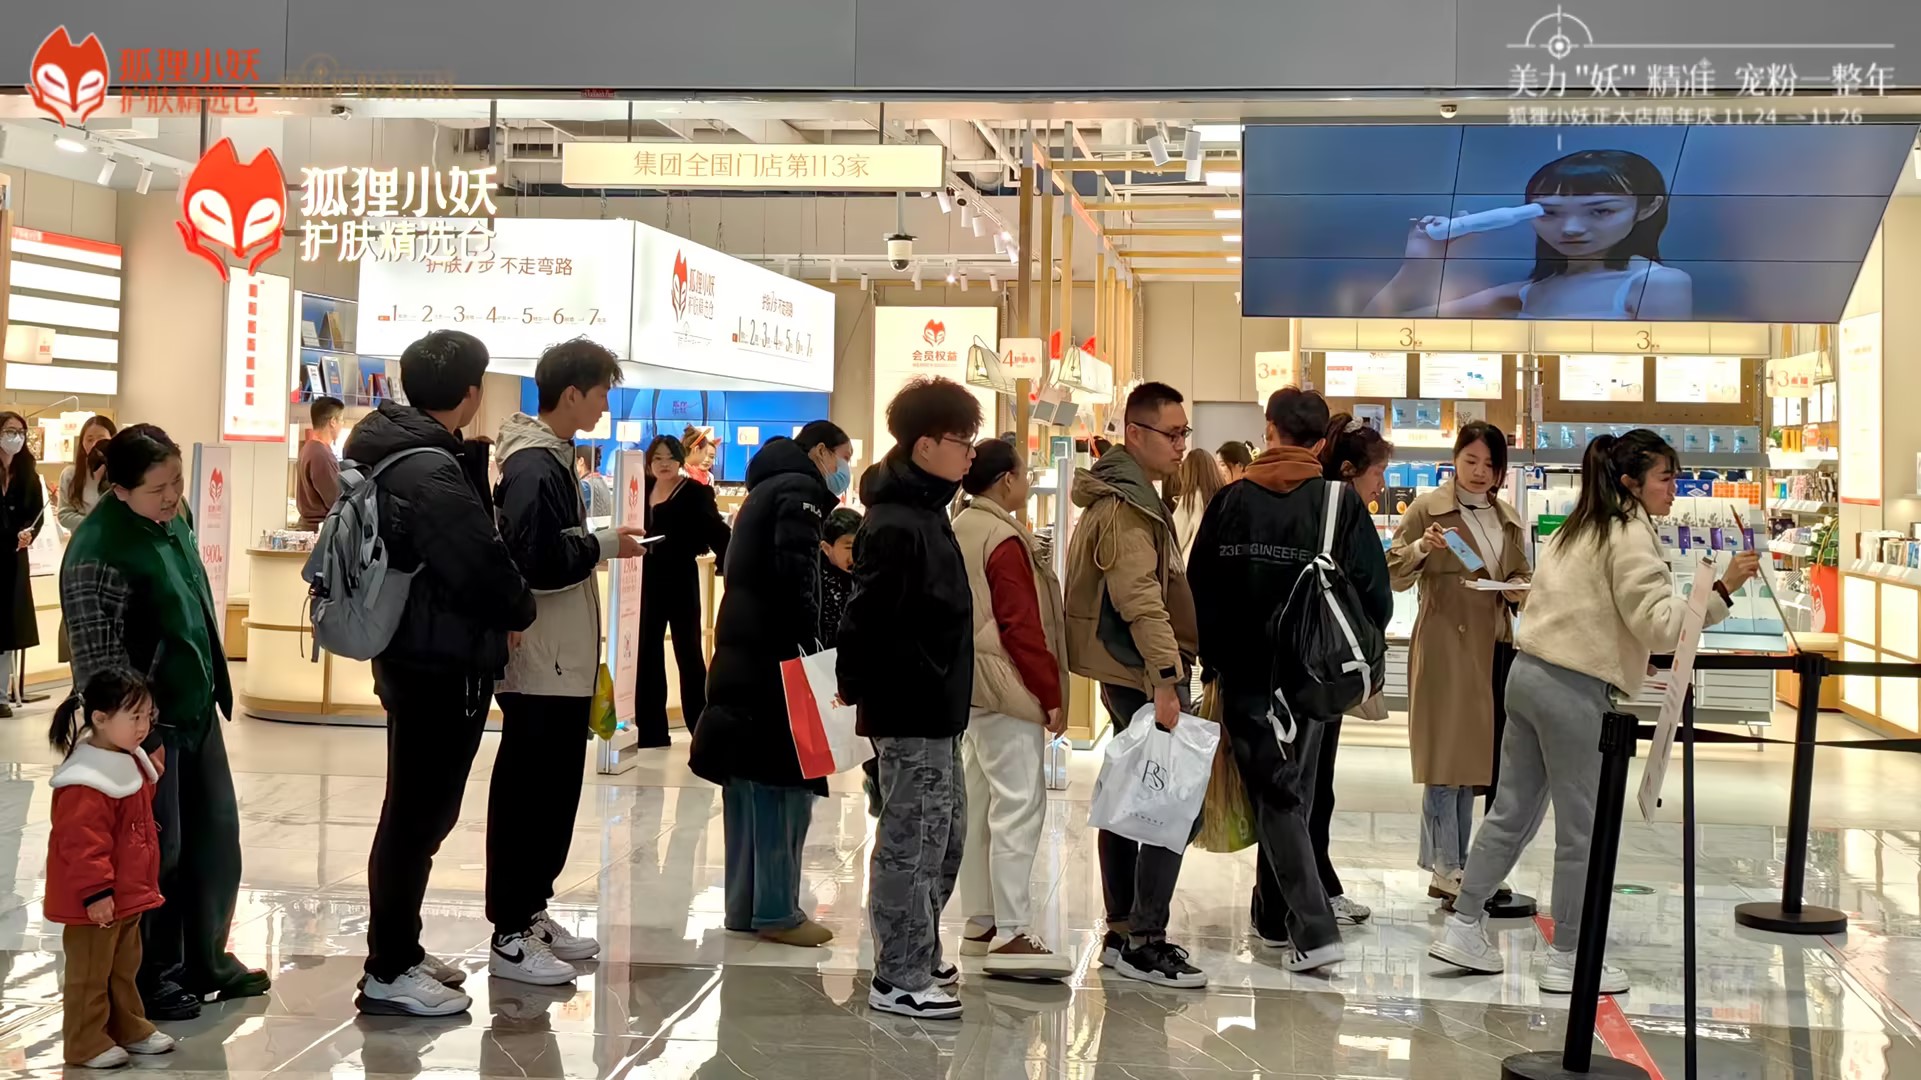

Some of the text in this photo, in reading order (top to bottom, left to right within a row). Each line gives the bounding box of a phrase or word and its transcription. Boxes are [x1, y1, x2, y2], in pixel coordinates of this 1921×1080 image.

[633, 150, 870, 178] 集团全国门店第113家
[300, 165, 498, 217] 狐狸小妖
[300, 219, 498, 263] 护肤精选仓
[500, 256, 574, 277] 不走弯路
[391, 304, 600, 326] 1 2 3 4 5 6 7
[1399, 327, 1413, 347] 3
[1636, 330, 1650, 350] 3
[911, 349, 958, 363] 会员权益
[1002, 349, 1013, 368] 4
[1258, 362, 1270, 380] 3
[1777, 370, 1789, 387] 3
[802, 501, 823, 518] FILA
